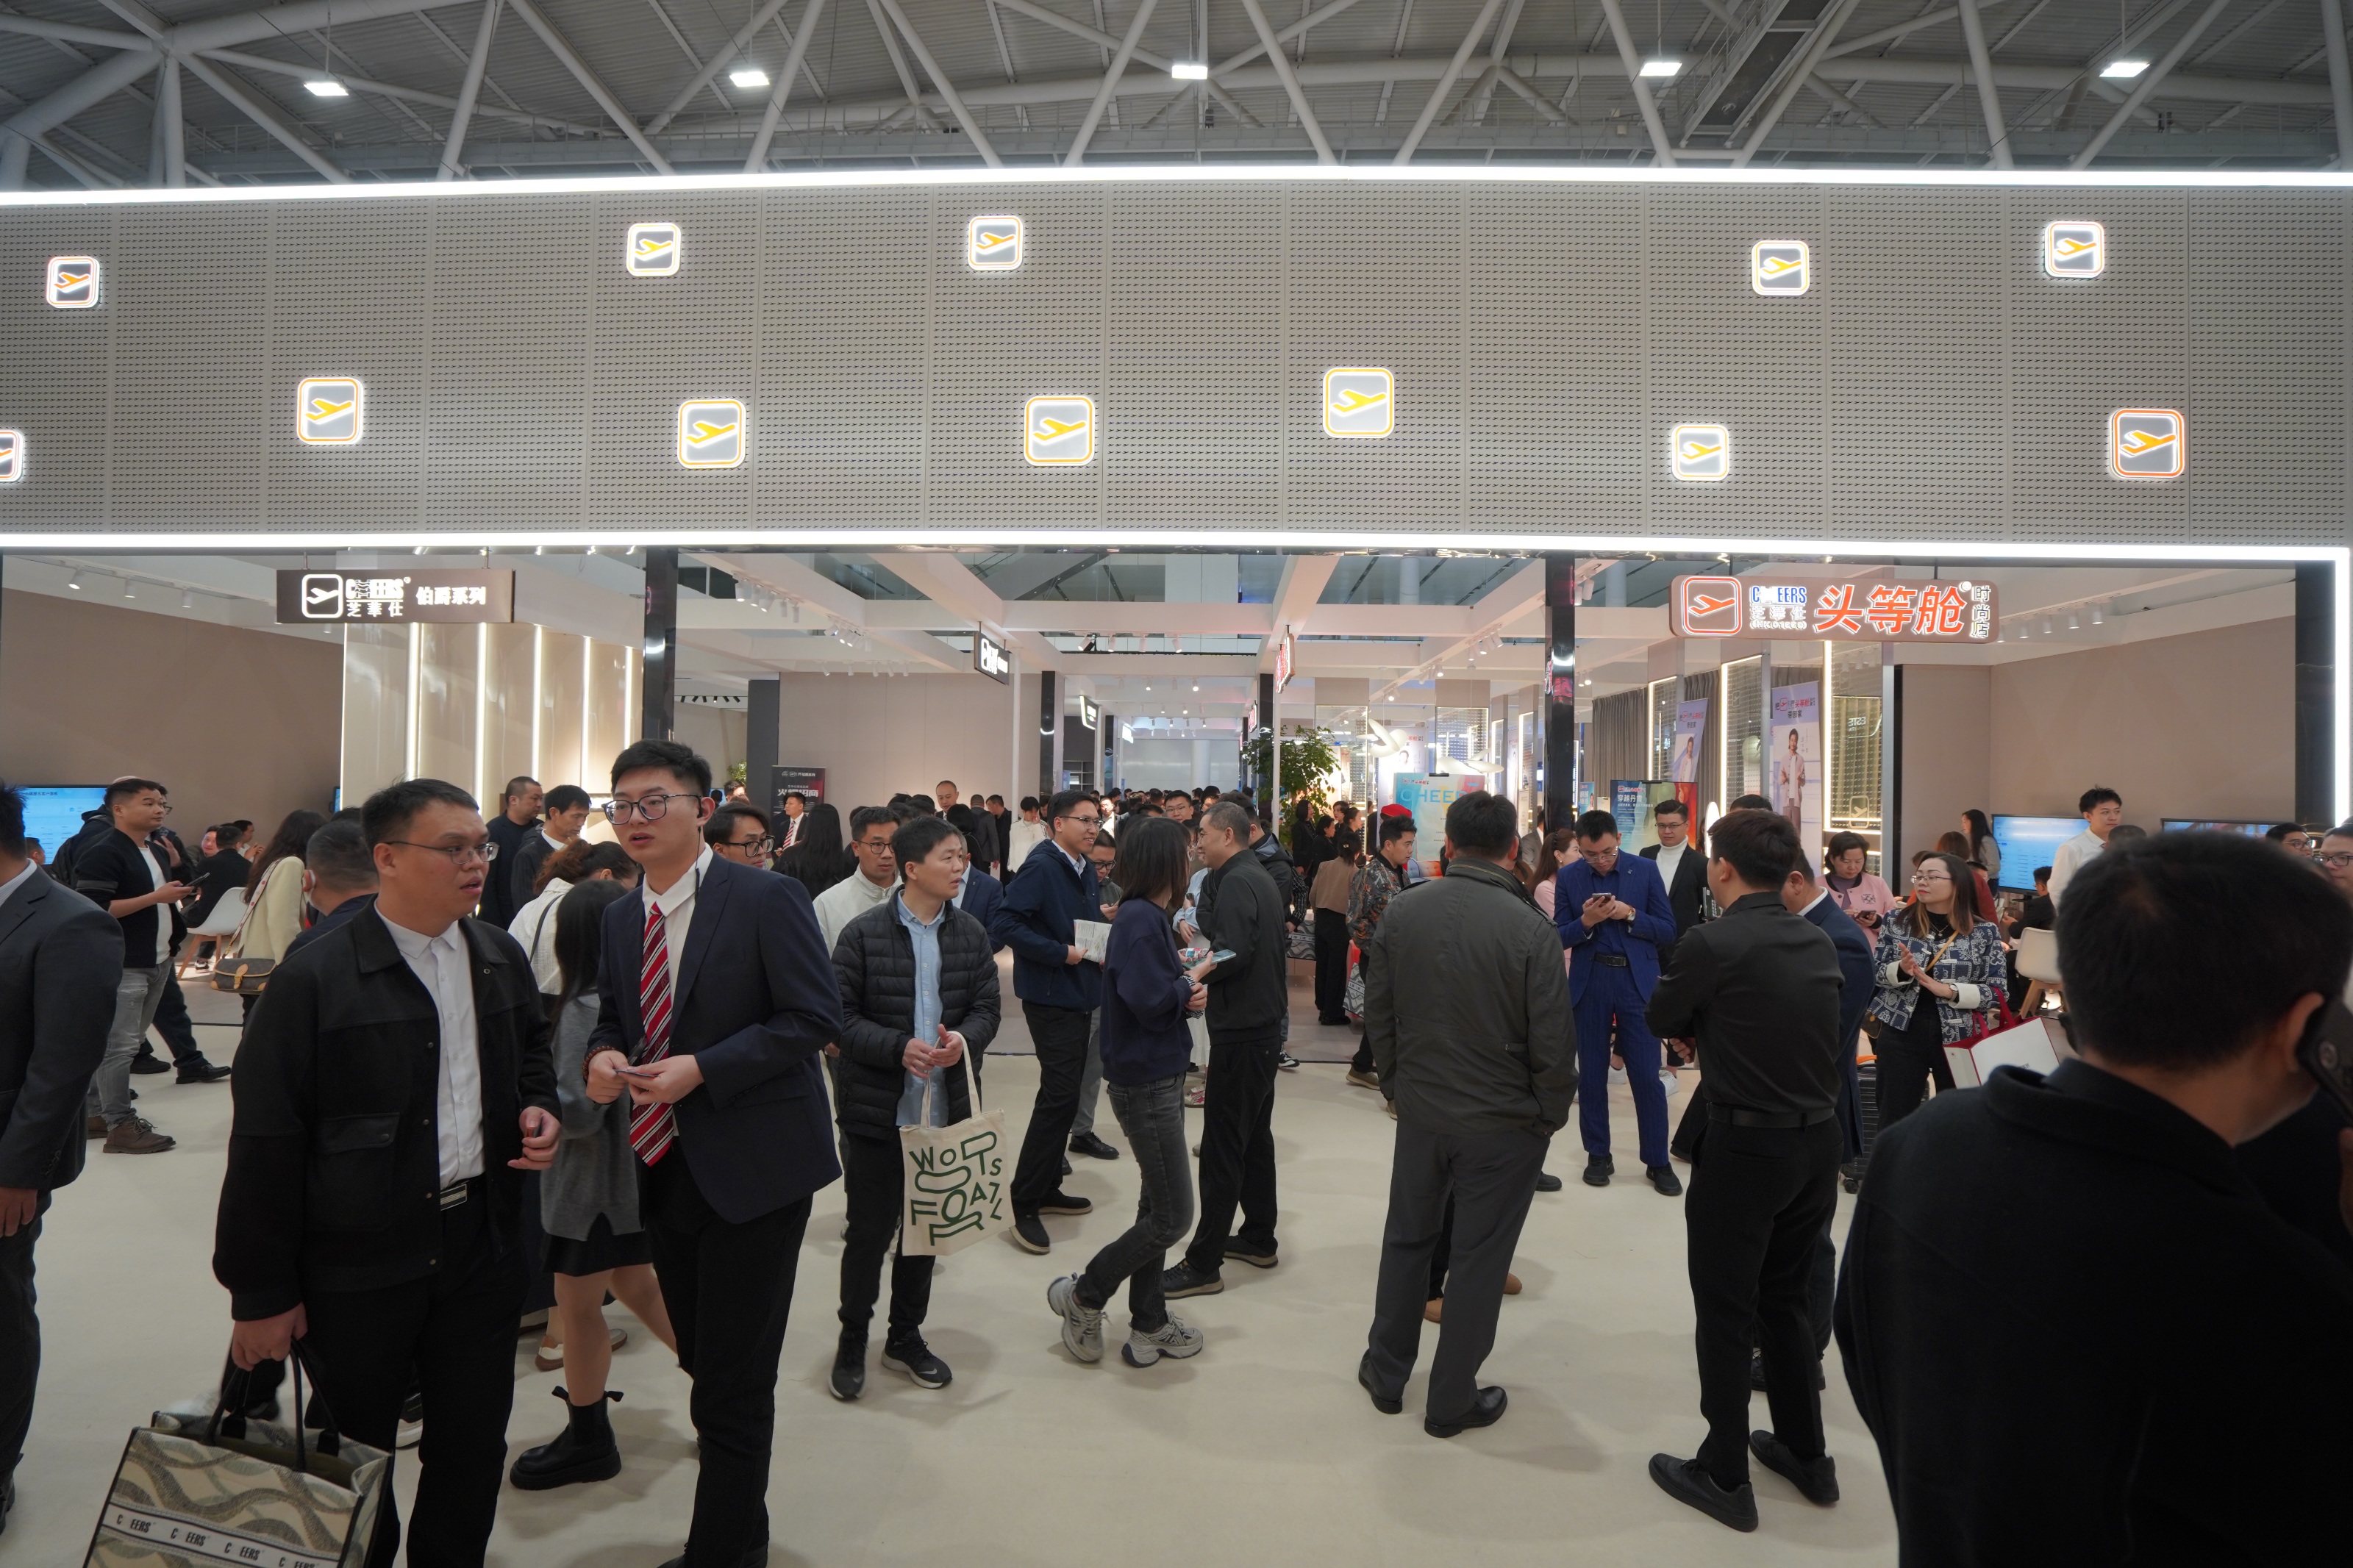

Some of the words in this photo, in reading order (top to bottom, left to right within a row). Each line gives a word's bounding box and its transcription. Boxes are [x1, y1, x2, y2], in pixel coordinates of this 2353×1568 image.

[416, 587, 486, 605] 伯爵系列
[1814, 584, 1966, 634] 头等舱
[1970, 585, 1991, 638] 时尚店
